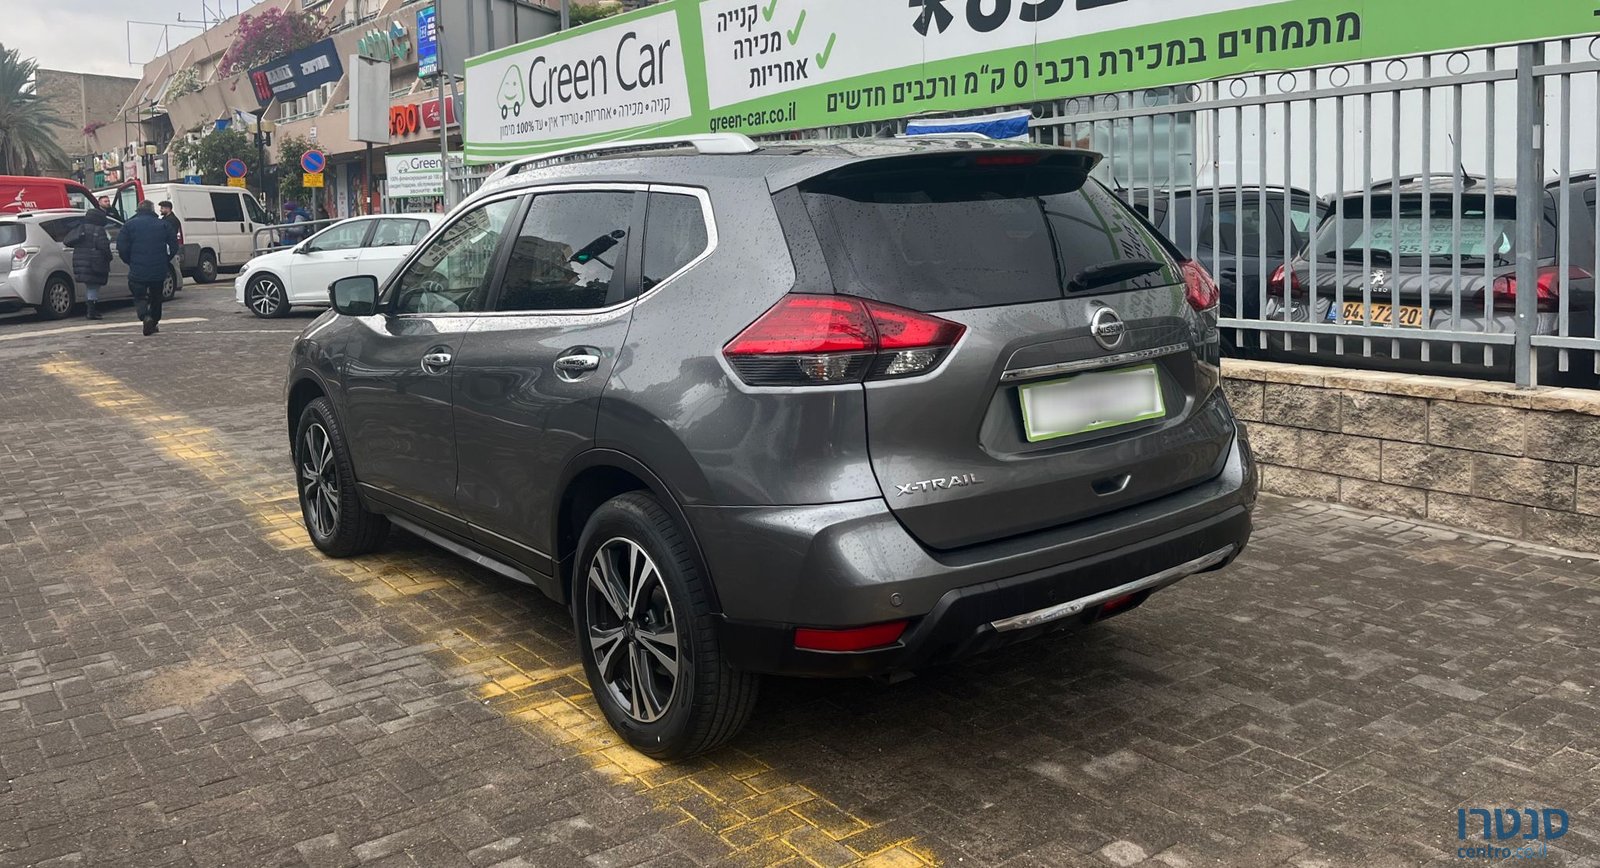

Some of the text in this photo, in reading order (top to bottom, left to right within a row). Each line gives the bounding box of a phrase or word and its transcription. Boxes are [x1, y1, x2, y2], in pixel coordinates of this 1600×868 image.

[717, 4, 758, 33] קנייה
[734, 31, 782, 60] מכירה
[1218, 11, 1361, 59] מתמחים
[528, 31, 671, 108] Green Car
[1034, 55, 1090, 84] רכבי
[1098, 36, 1207, 77] במכירת
[749, 57, 809, 89] אחריות
[826, 86, 886, 113] חדשים
[892, 74, 956, 104] ורכבים
[585, 107, 612, 123] אחריות
[618, 101, 644, 118] מכירה
[650, 97, 671, 115] קניה
[710, 101, 797, 132] green-car.co.il
[516, 121, 535, 135] 100%
[410, 157, 443, 170] Green
[895, 473, 984, 497] X-TRAIL
